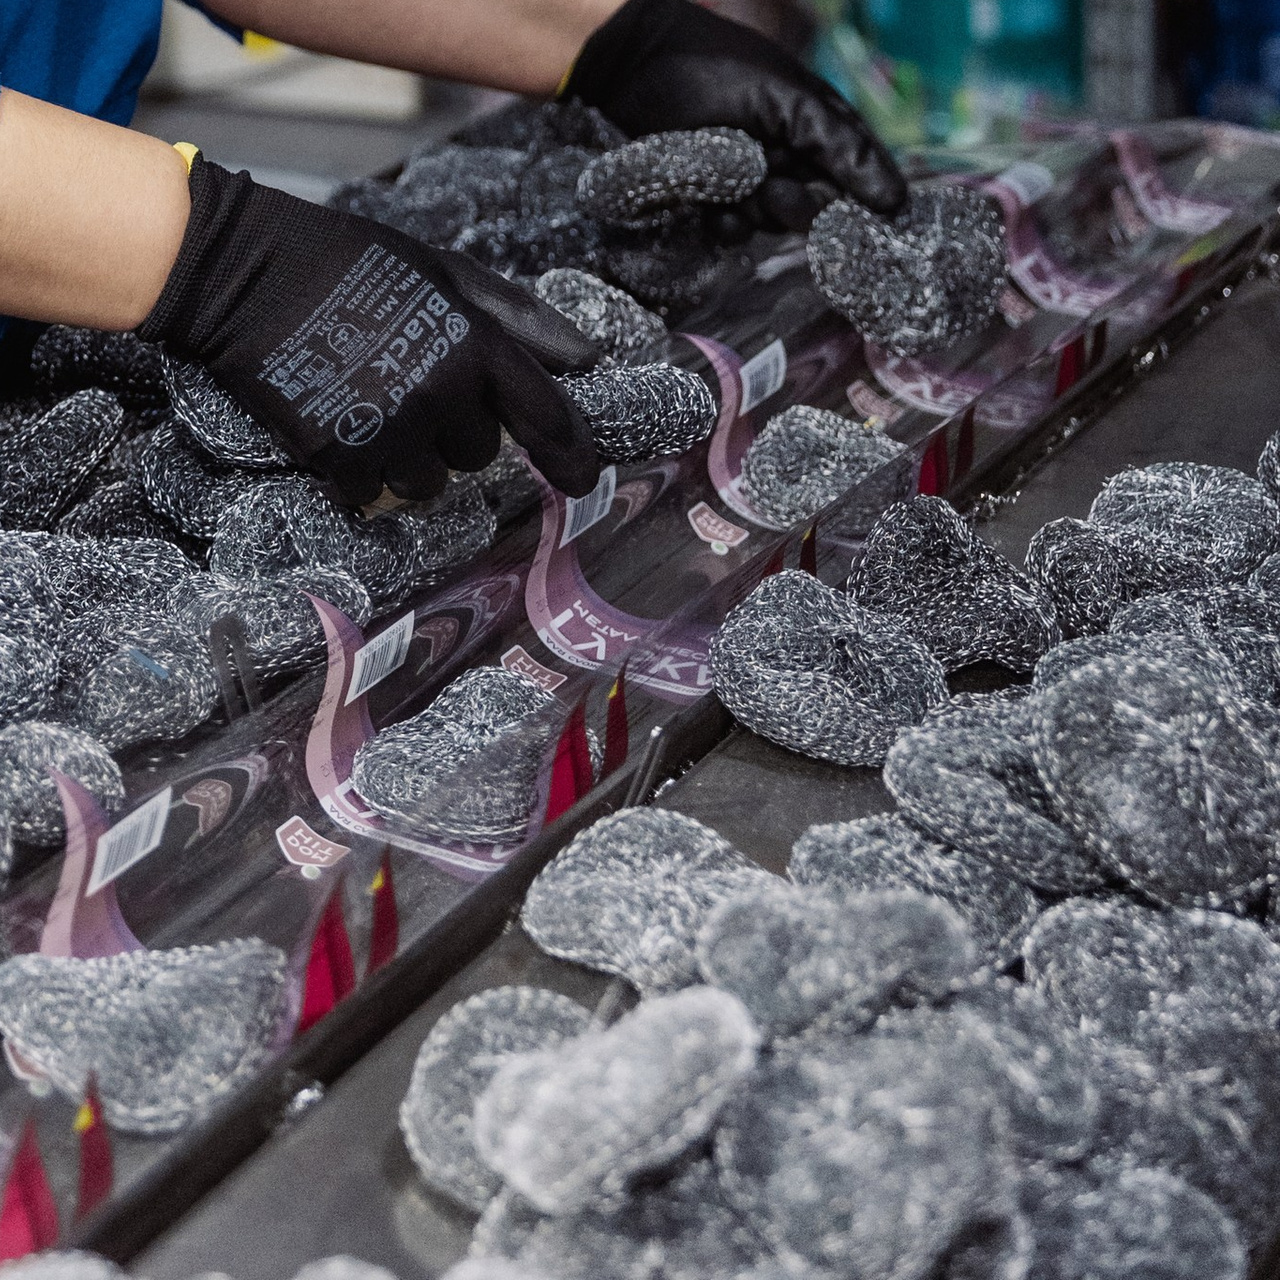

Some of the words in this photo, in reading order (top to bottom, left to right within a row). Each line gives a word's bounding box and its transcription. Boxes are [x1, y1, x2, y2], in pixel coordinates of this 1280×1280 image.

[290, 280, 346, 340] Development
[320, 294, 346, 322] Good
[285, 317, 324, 355] Working
[367, 289, 452, 383] Black
[254, 350, 289, 383] Apparel
[341, 410, 363, 430] 7
